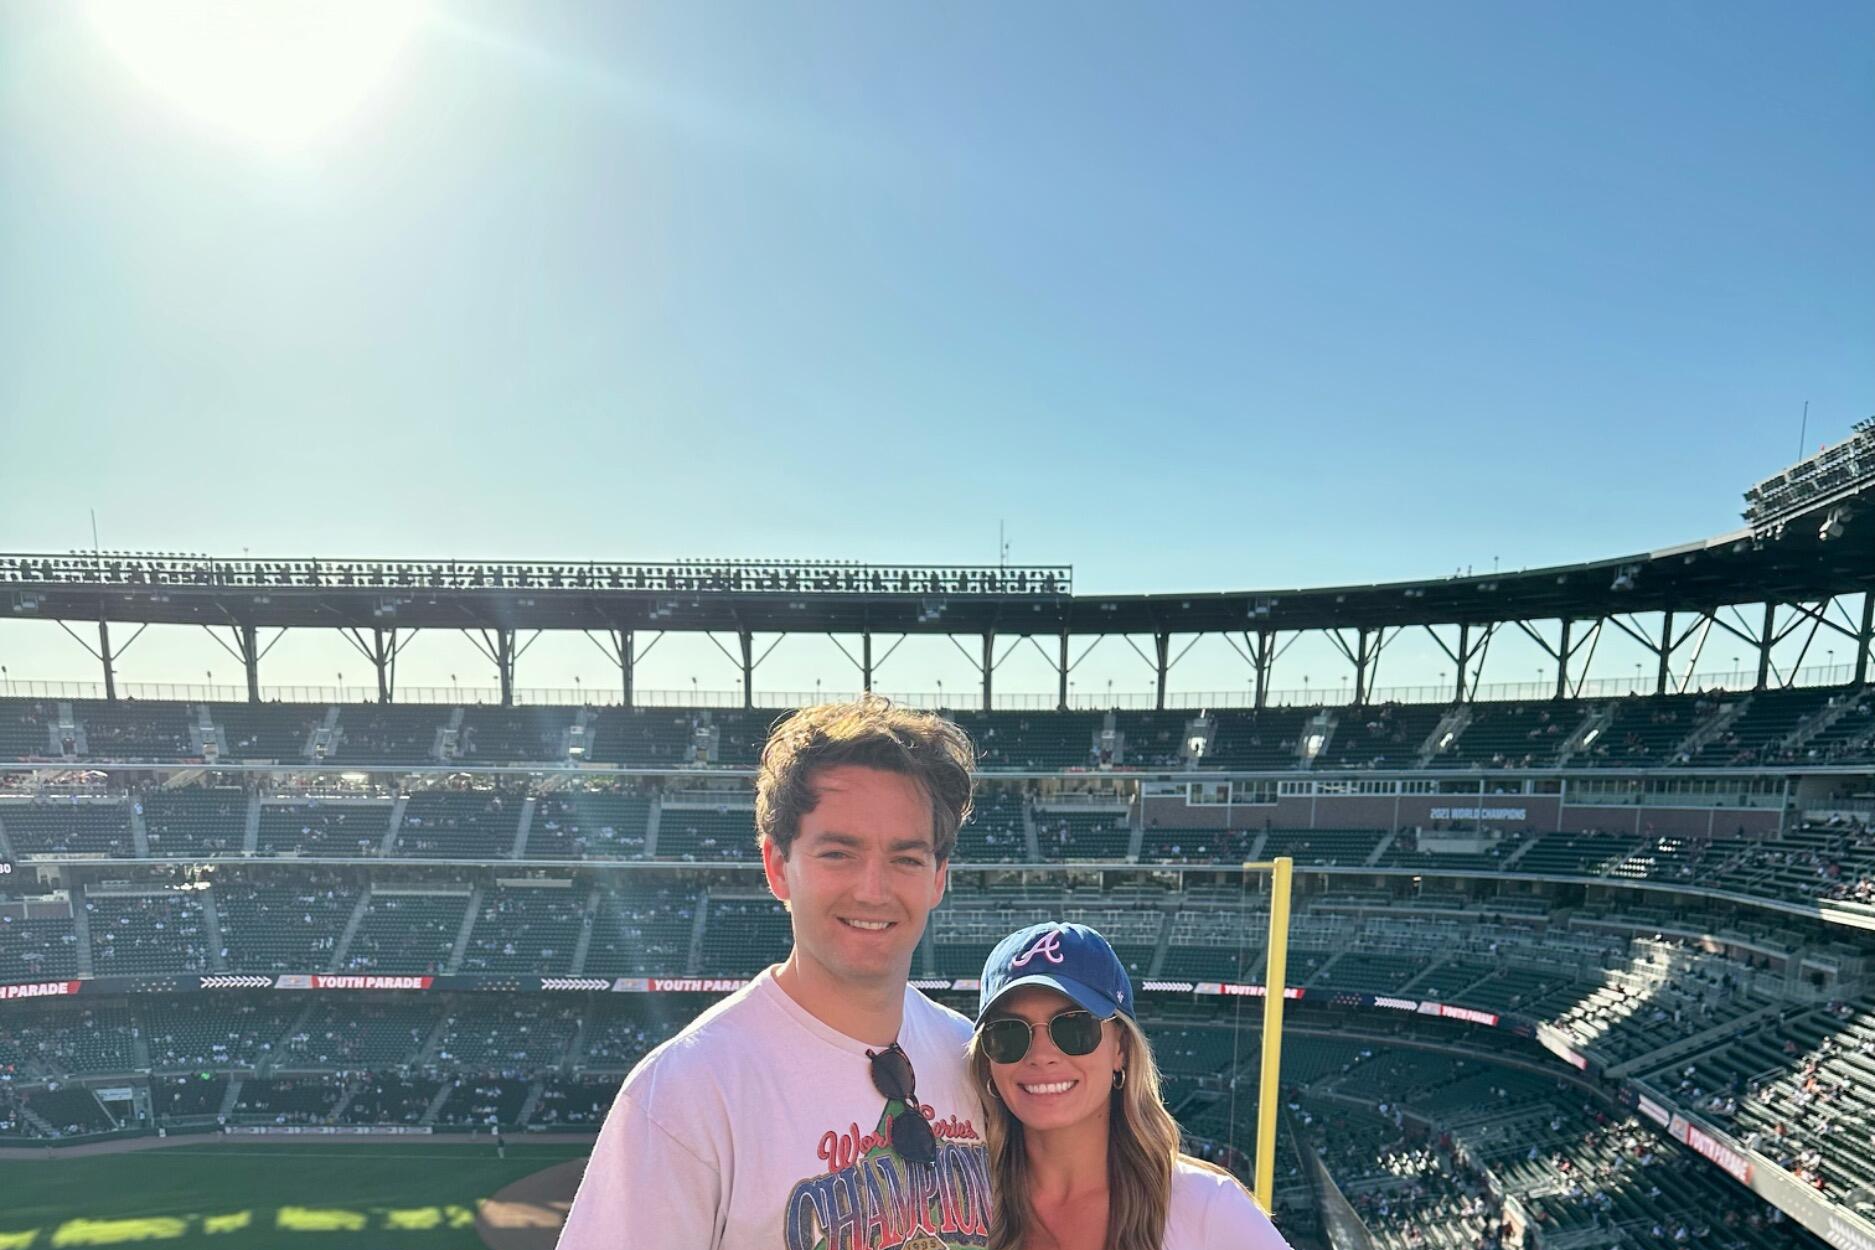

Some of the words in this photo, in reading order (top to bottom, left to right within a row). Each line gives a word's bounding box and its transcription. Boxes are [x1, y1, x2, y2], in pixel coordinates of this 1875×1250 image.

[1011, 929, 1064, 967] A
[318, 976, 366, 988] YOUTH
[366, 976, 422, 989] PARADE
[654, 979, 702, 992] YOUTH
[702, 979, 751, 992] PARA
[8, 982, 68, 998] PARADE
[1225, 984, 1258, 996] YOUTH
[817, 1114, 895, 1173] Worl
